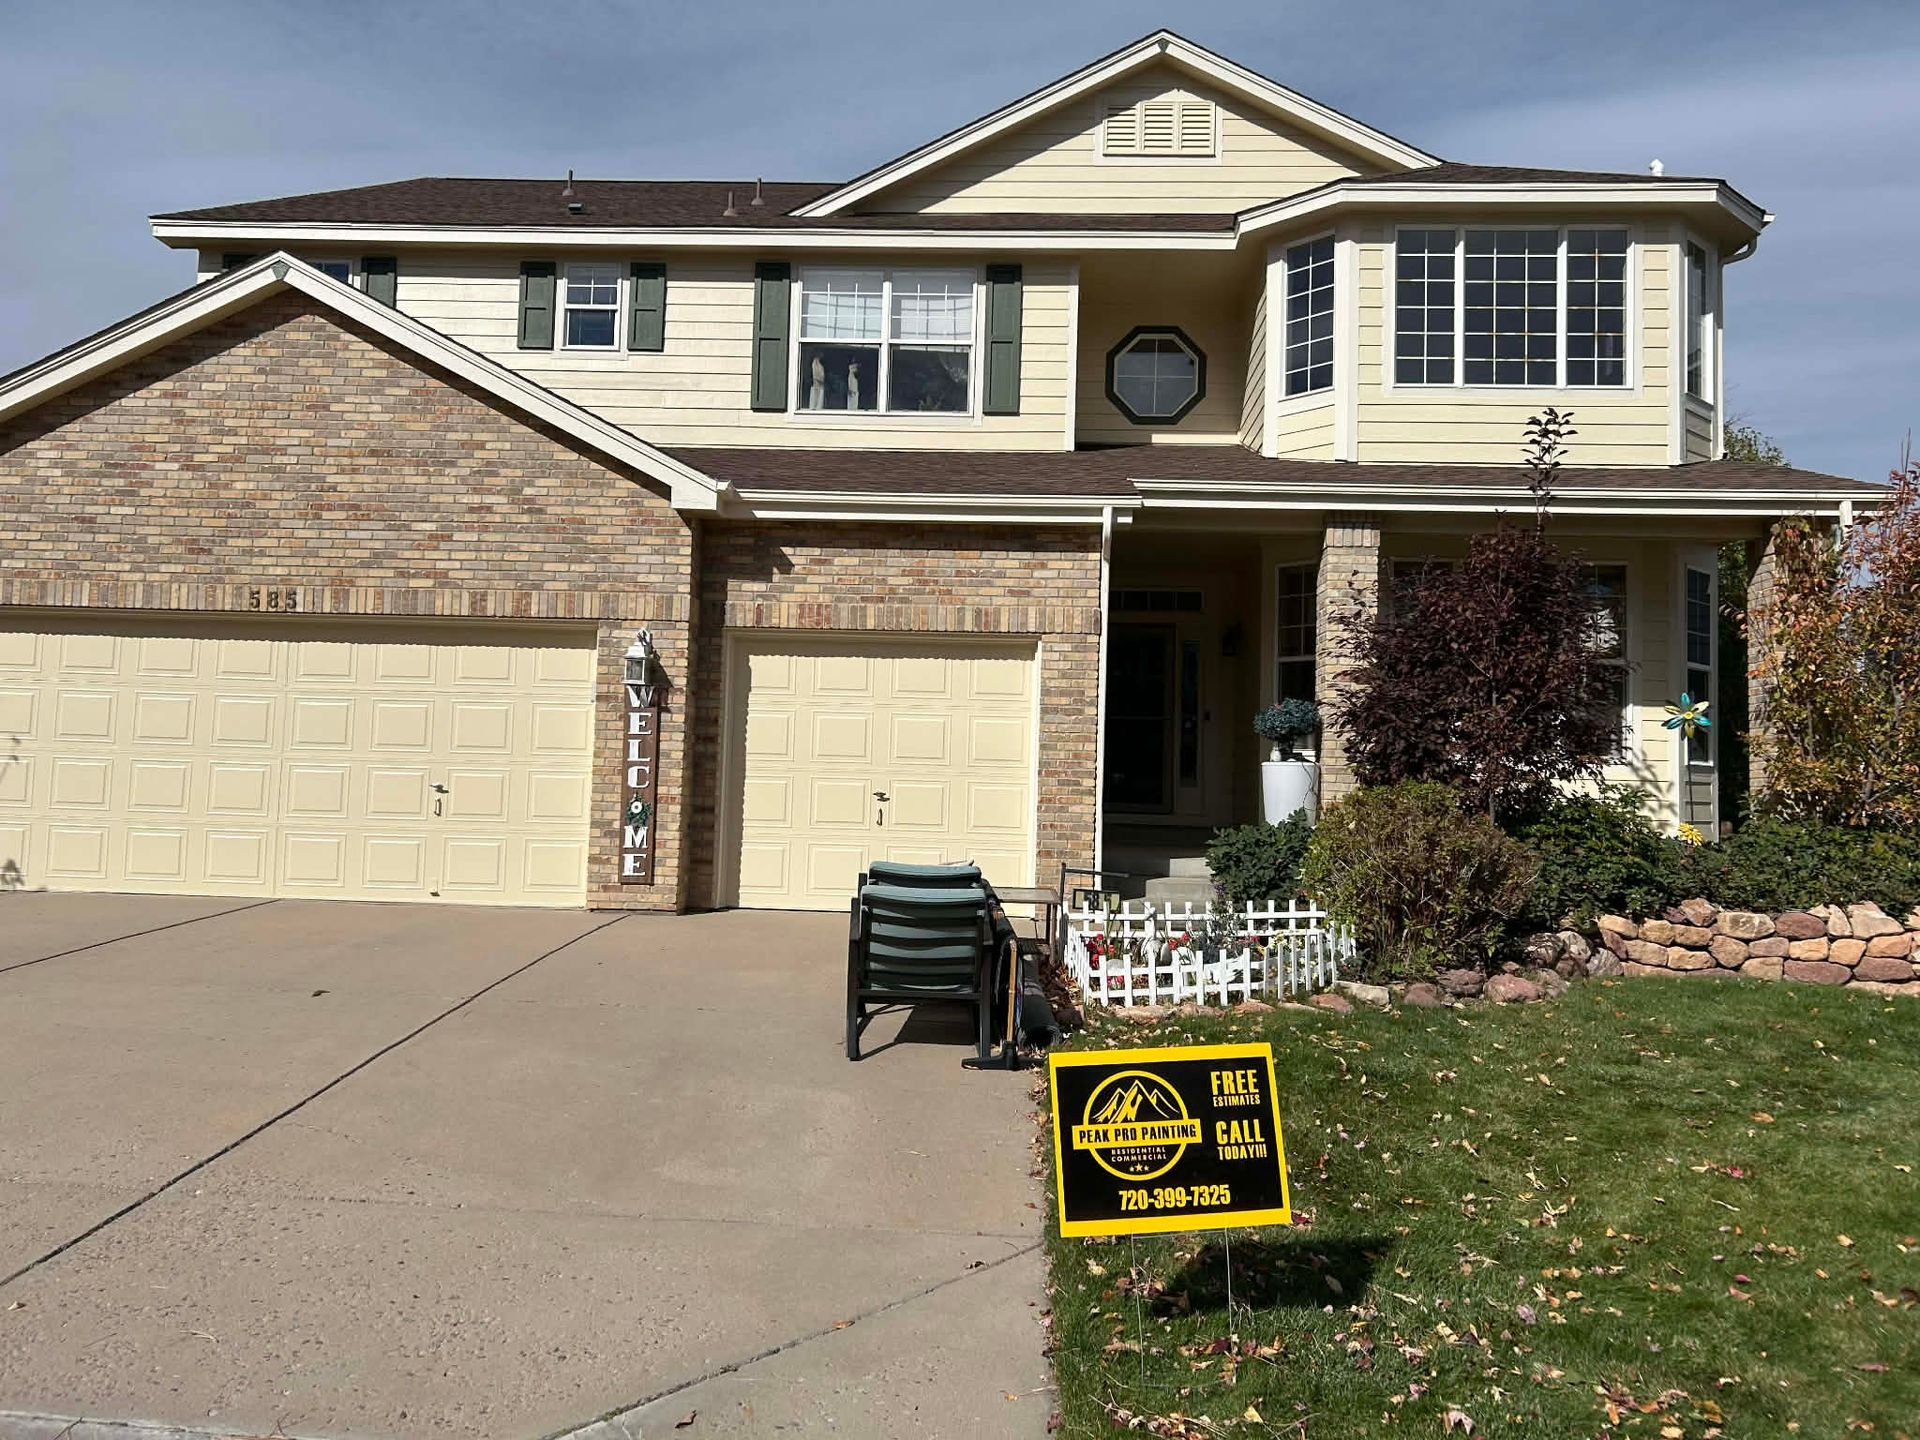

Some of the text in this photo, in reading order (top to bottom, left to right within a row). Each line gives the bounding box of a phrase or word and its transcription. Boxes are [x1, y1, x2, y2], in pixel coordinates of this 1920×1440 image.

[250, 590, 297, 609] 585
[1210, 1069, 1259, 1096] FREE
[1212, 1094, 1261, 1107] ESTIMATES
[1079, 1123, 1197, 1144] PEAK PRO PAINTING
[1215, 1118, 1265, 1145] CALL
[1111, 1146, 1166, 1155] RESIDENTIAL
[1111, 1153, 1167, 1163] COMMERCIAL
[1217, 1143, 1267, 1161] TODAY!!!
[1118, 1185, 1231, 1211] 720-399-7325
